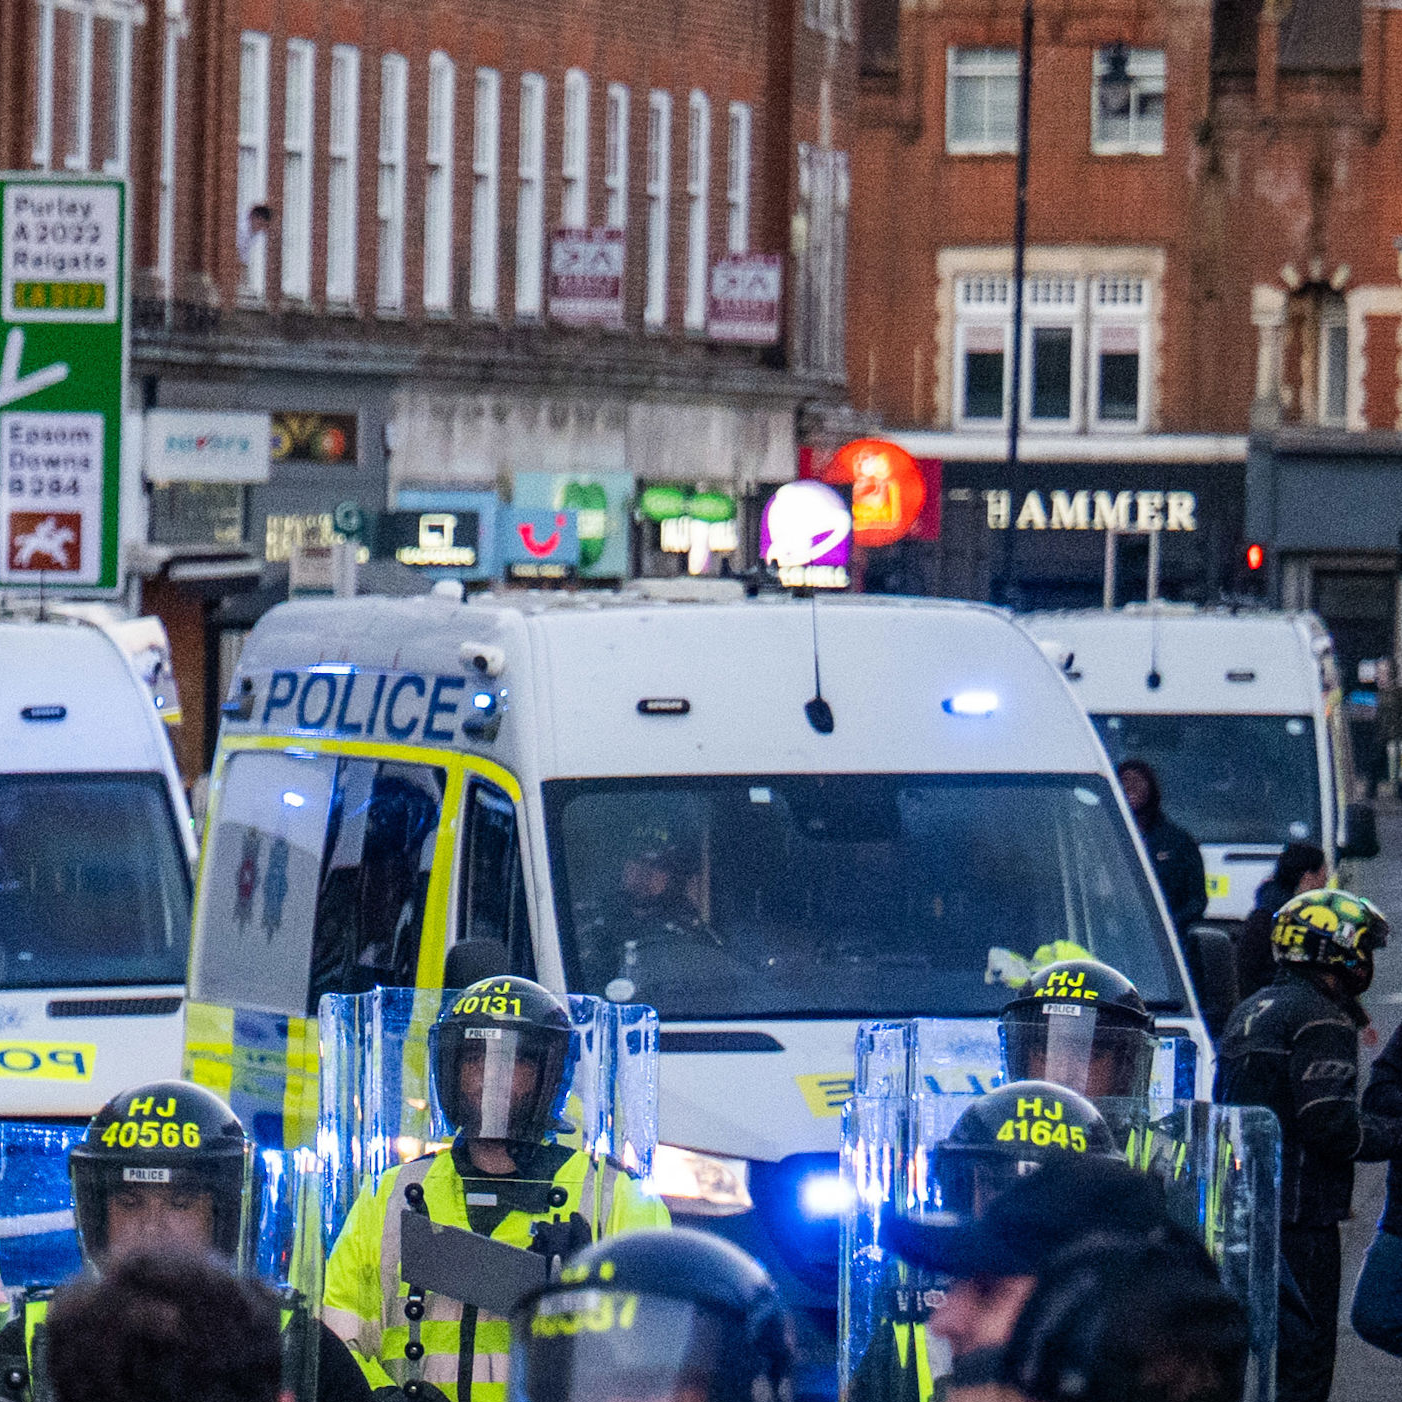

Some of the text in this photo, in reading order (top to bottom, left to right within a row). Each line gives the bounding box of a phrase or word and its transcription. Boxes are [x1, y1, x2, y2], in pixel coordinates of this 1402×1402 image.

[14, 196, 91, 219] Purley
[14, 251, 107, 273] Reigate
[9, 423, 91, 447] Epsom
[9, 450, 91, 472] Downs
[984, 489, 1196, 531] HAMMER
[262, 671, 466, 741] POLICE
[1047, 971, 1085, 987] HJ
[452, 995, 521, 1016] 40131
[1046, 1004, 1077, 1014] POLICE
[468, 1029, 497, 1038] POLICE
[128, 1096, 177, 1117] HJ
[1017, 1098, 1062, 1120] HJ
[100, 1121, 201, 1148] 40566
[997, 1120, 1087, 1152] 41645
[129, 1170, 165, 1180] POLICE
